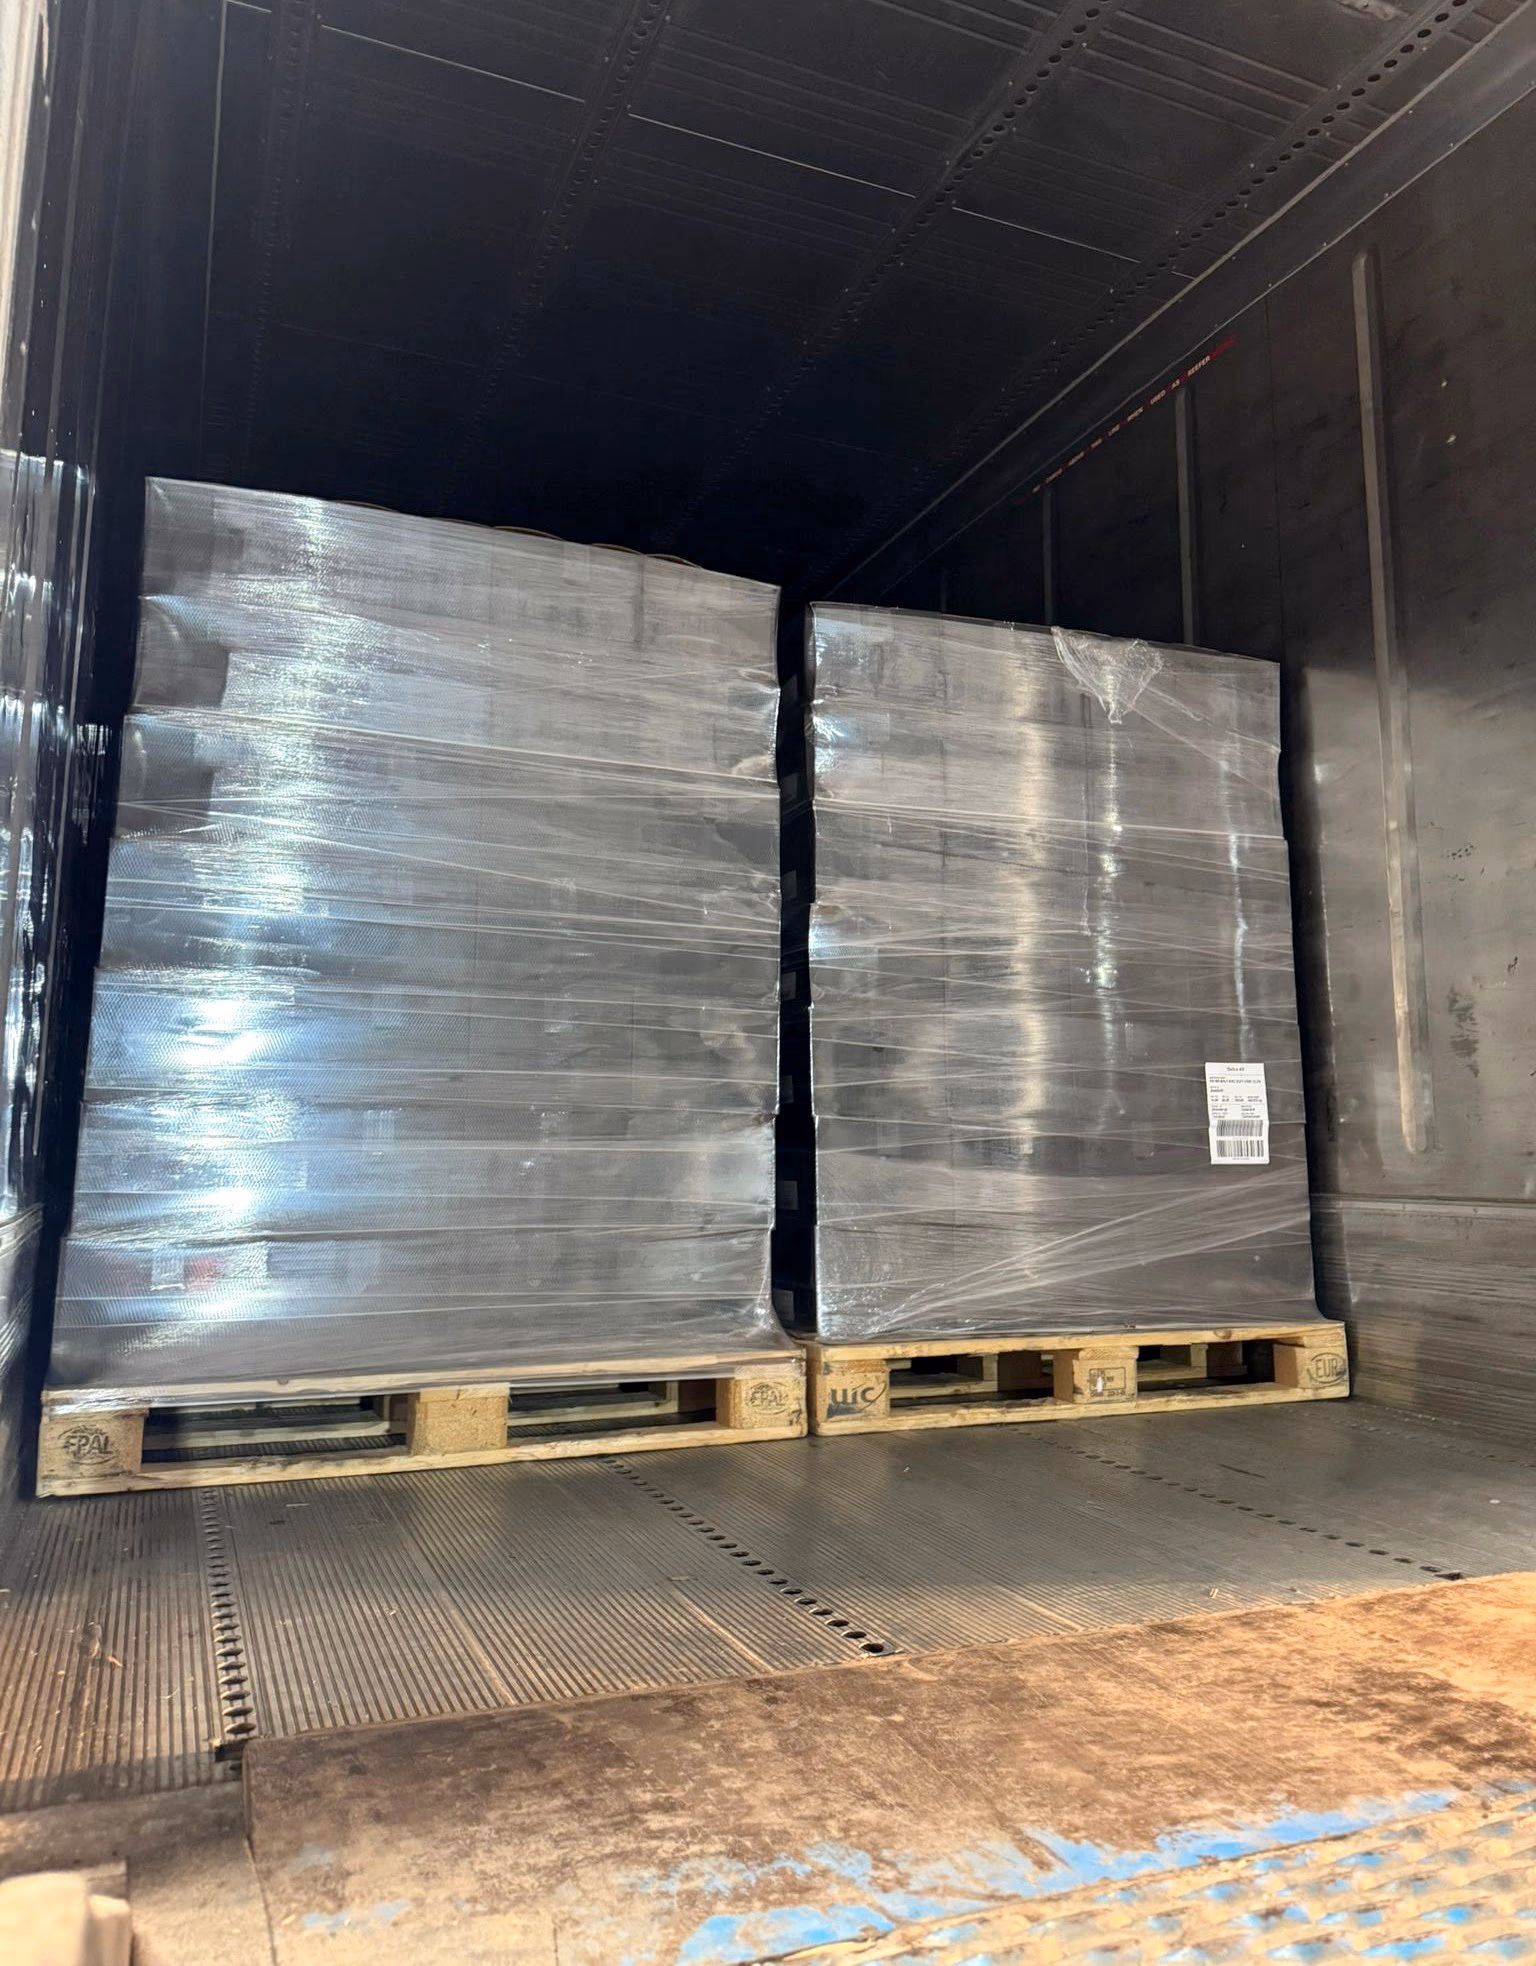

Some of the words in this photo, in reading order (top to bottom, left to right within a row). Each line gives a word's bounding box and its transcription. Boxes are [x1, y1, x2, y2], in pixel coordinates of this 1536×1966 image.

[1150, 389, 1166, 405] USED
[1171, 378, 1181, 390] AS
[1187, 355, 1211, 377] REEFER
[1315, 1358, 1339, 1378] EUR
